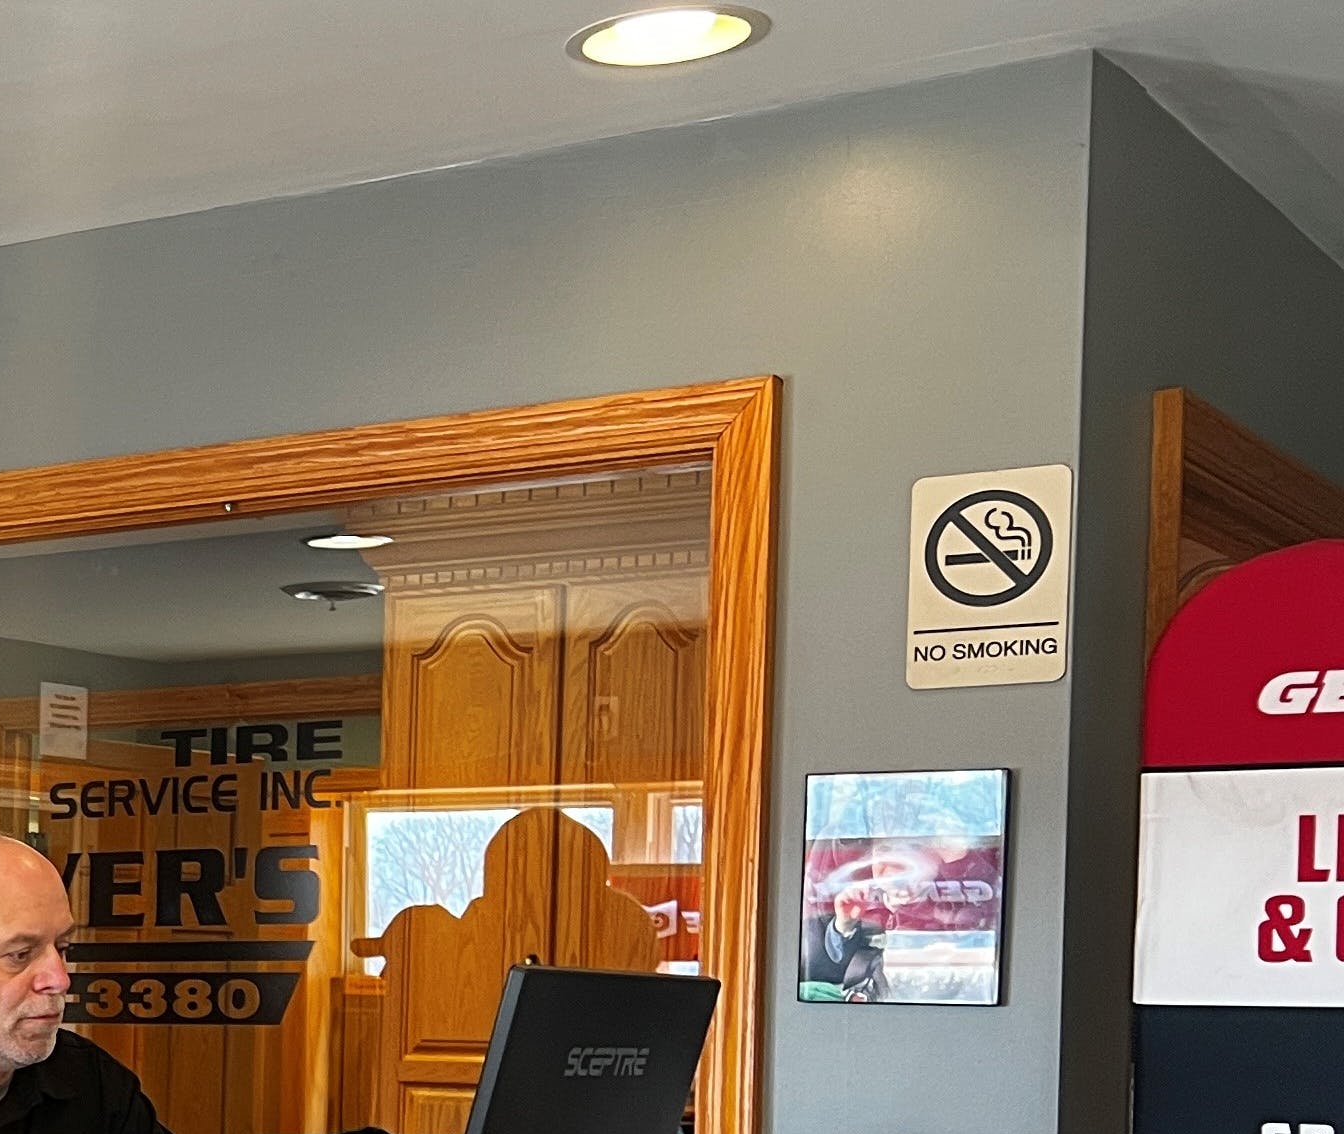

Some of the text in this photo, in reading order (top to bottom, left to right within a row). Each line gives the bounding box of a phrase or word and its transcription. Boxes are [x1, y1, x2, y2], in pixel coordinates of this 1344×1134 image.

[913, 637, 1058, 662] NO SMOKING
[161, 720, 343, 768] TIRE
[48, 769, 343, 820] SERVICE INC.
[1297, 814, 1344, 883] L
[1257, 894, 1313, 963] &
[563, 1047, 650, 1077] SCEPTRE
